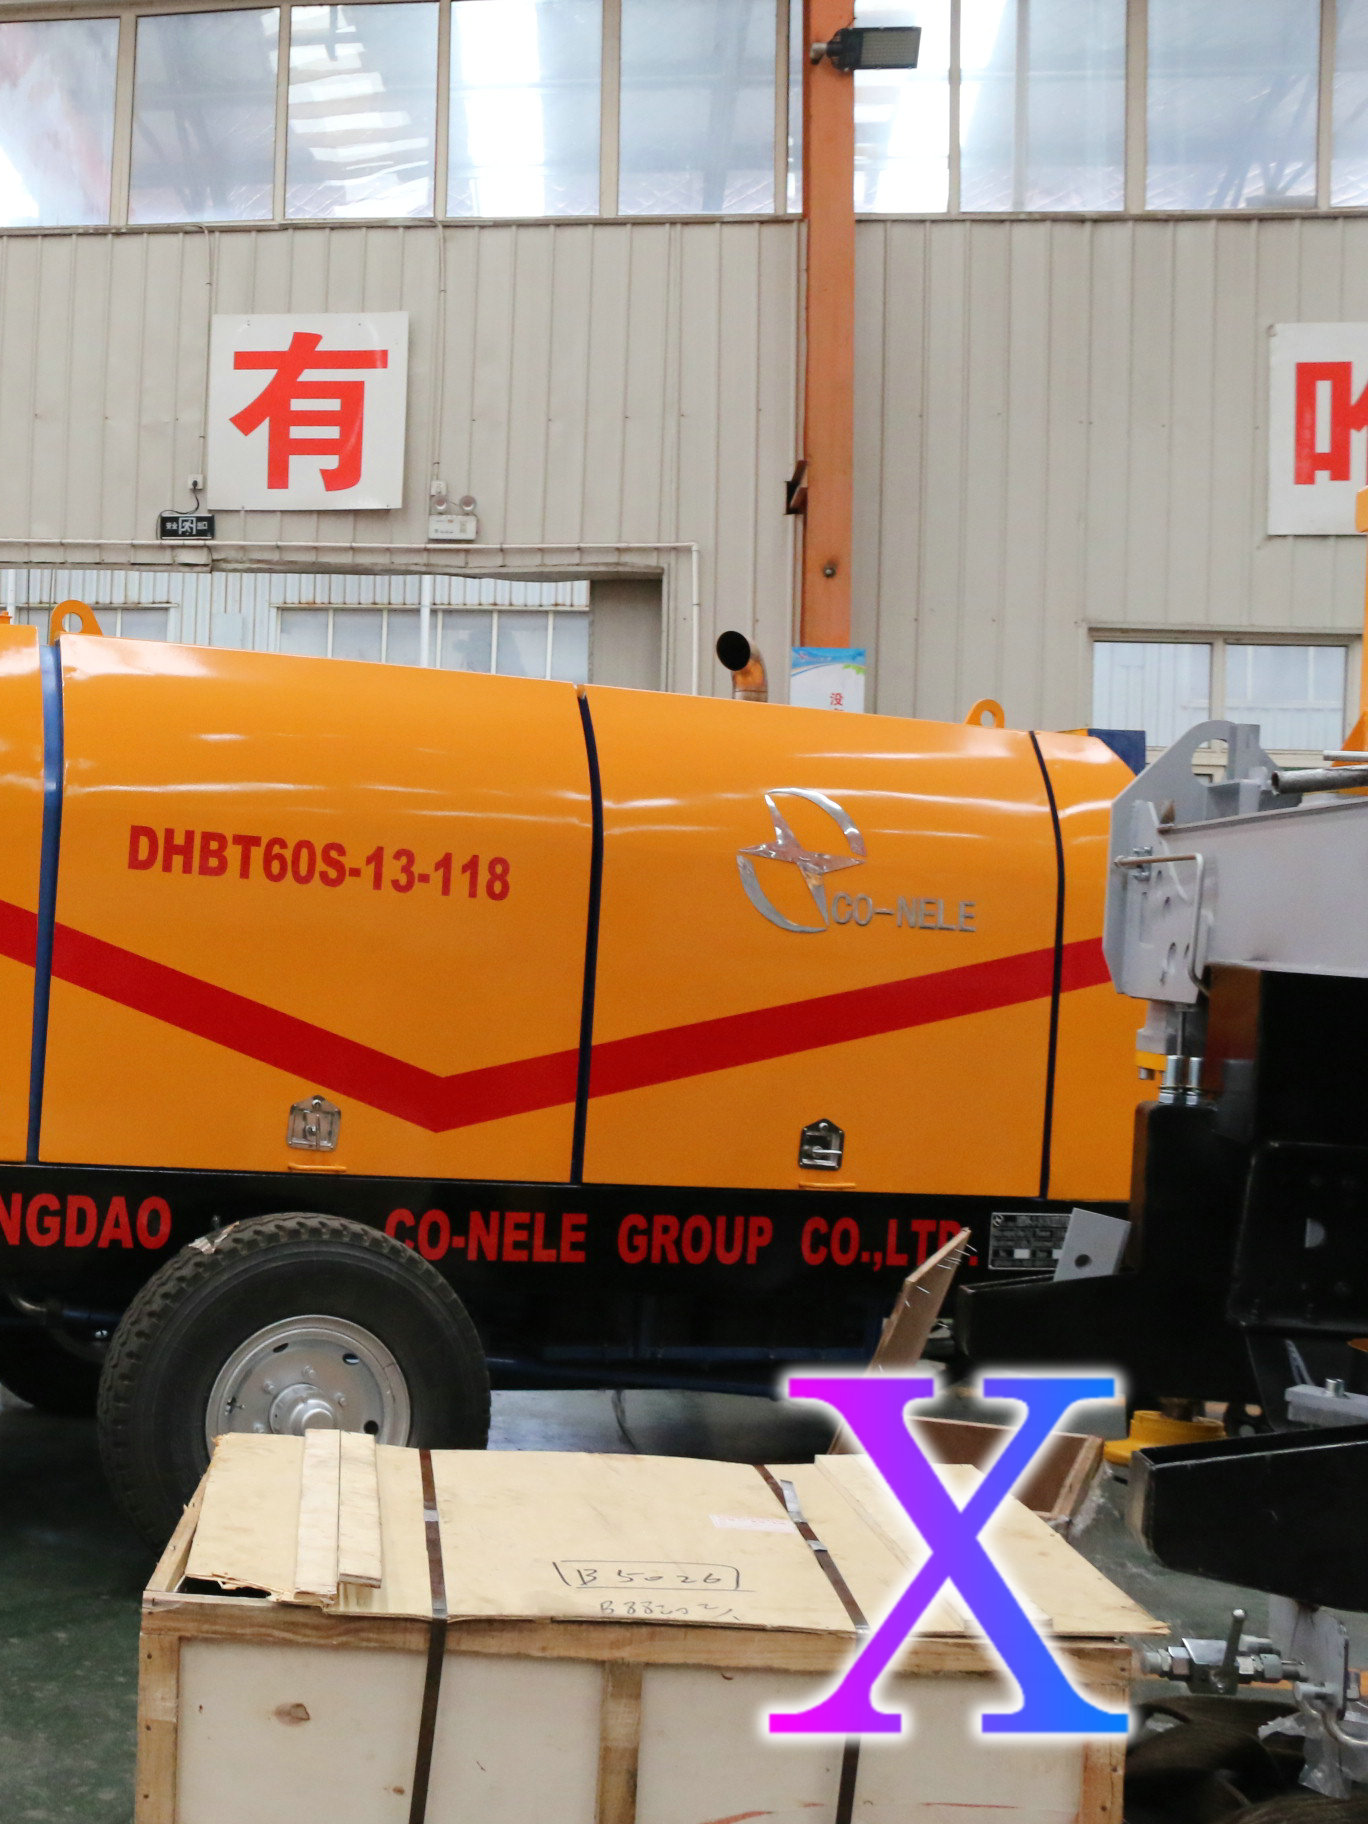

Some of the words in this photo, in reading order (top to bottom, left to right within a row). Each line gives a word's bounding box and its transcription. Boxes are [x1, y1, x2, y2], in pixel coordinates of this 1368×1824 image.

[229, 331, 389, 492] 有
[127, 825, 511, 901] DHBT60S-13-118
[832, 891, 976, 932] CO-NELE
[384, 1207, 588, 1263] CO-NELE
[617, 1213, 773, 1265] GROUP
